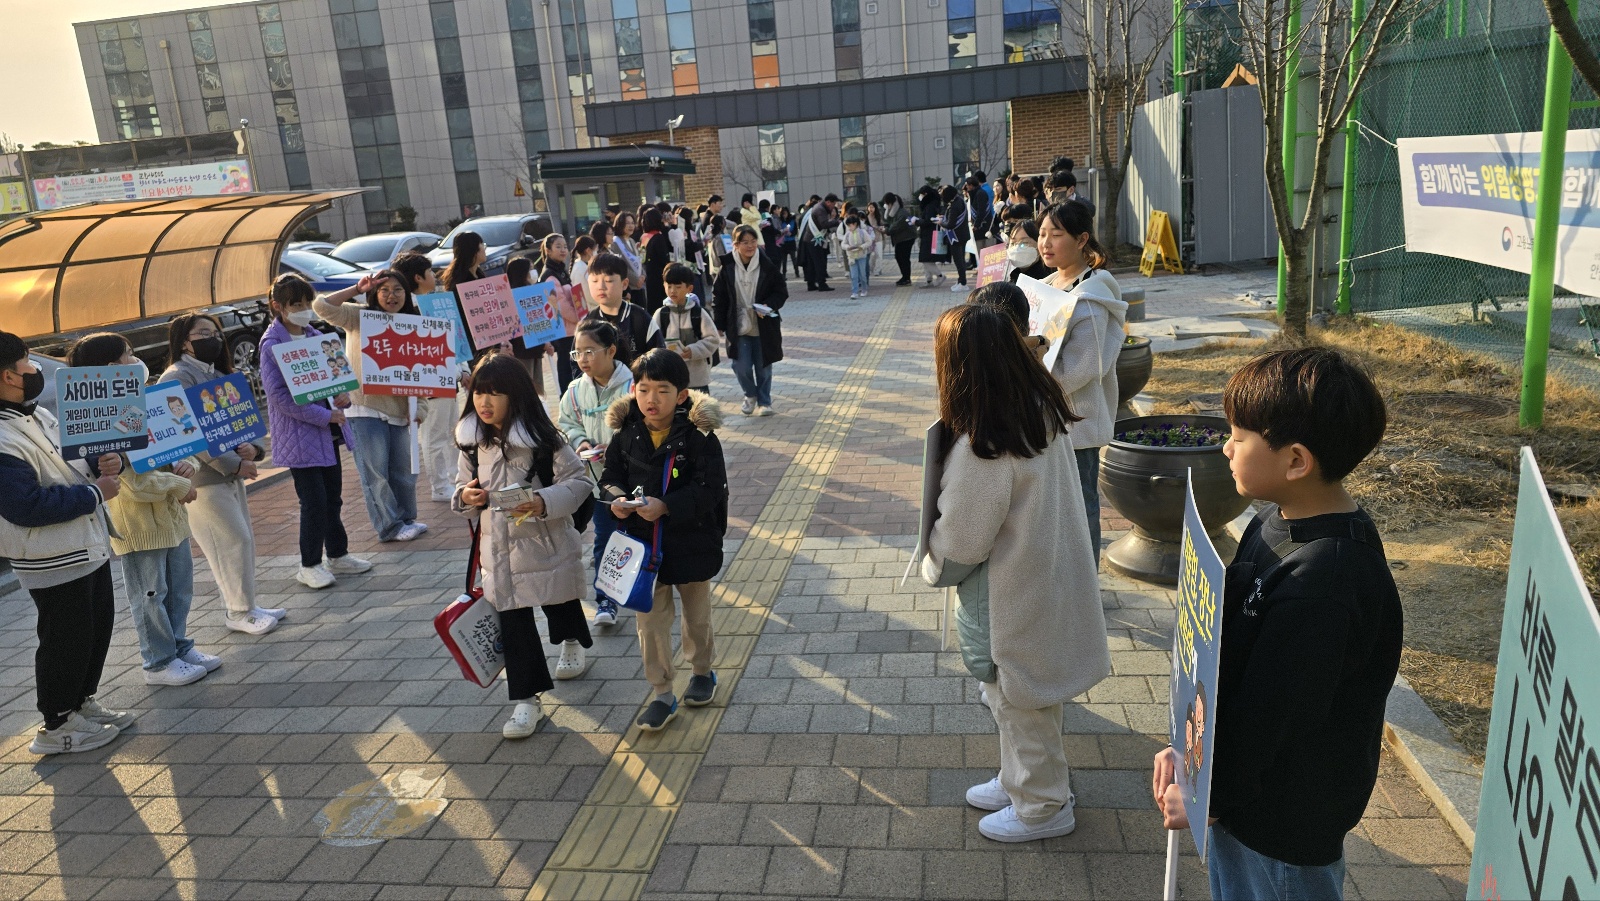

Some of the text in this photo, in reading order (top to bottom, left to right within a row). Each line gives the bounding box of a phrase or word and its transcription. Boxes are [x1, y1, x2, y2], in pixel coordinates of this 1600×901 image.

[1418, 163, 1480, 196] 함께하는
[479, 283, 494, 296] 고민
[282, 348, 310, 364] 성폭력
[372, 338, 392, 358] 모두
[290, 359, 320, 374] 안전한
[292, 370, 329, 386] 우리학교
[394, 370, 420, 382] 따돌림
[438, 376, 454, 386] 강요
[64, 378, 140, 402] 사이버 도박
[65, 404, 118, 422] 게임이 아니라
[198, 414, 214, 426] 내가
[66, 420, 111, 436] 범죄입니다!
[205, 424, 232, 442] 친구에겐
[1520, 566, 1556, 727] 바른
[1504, 673, 1554, 901] 나의
